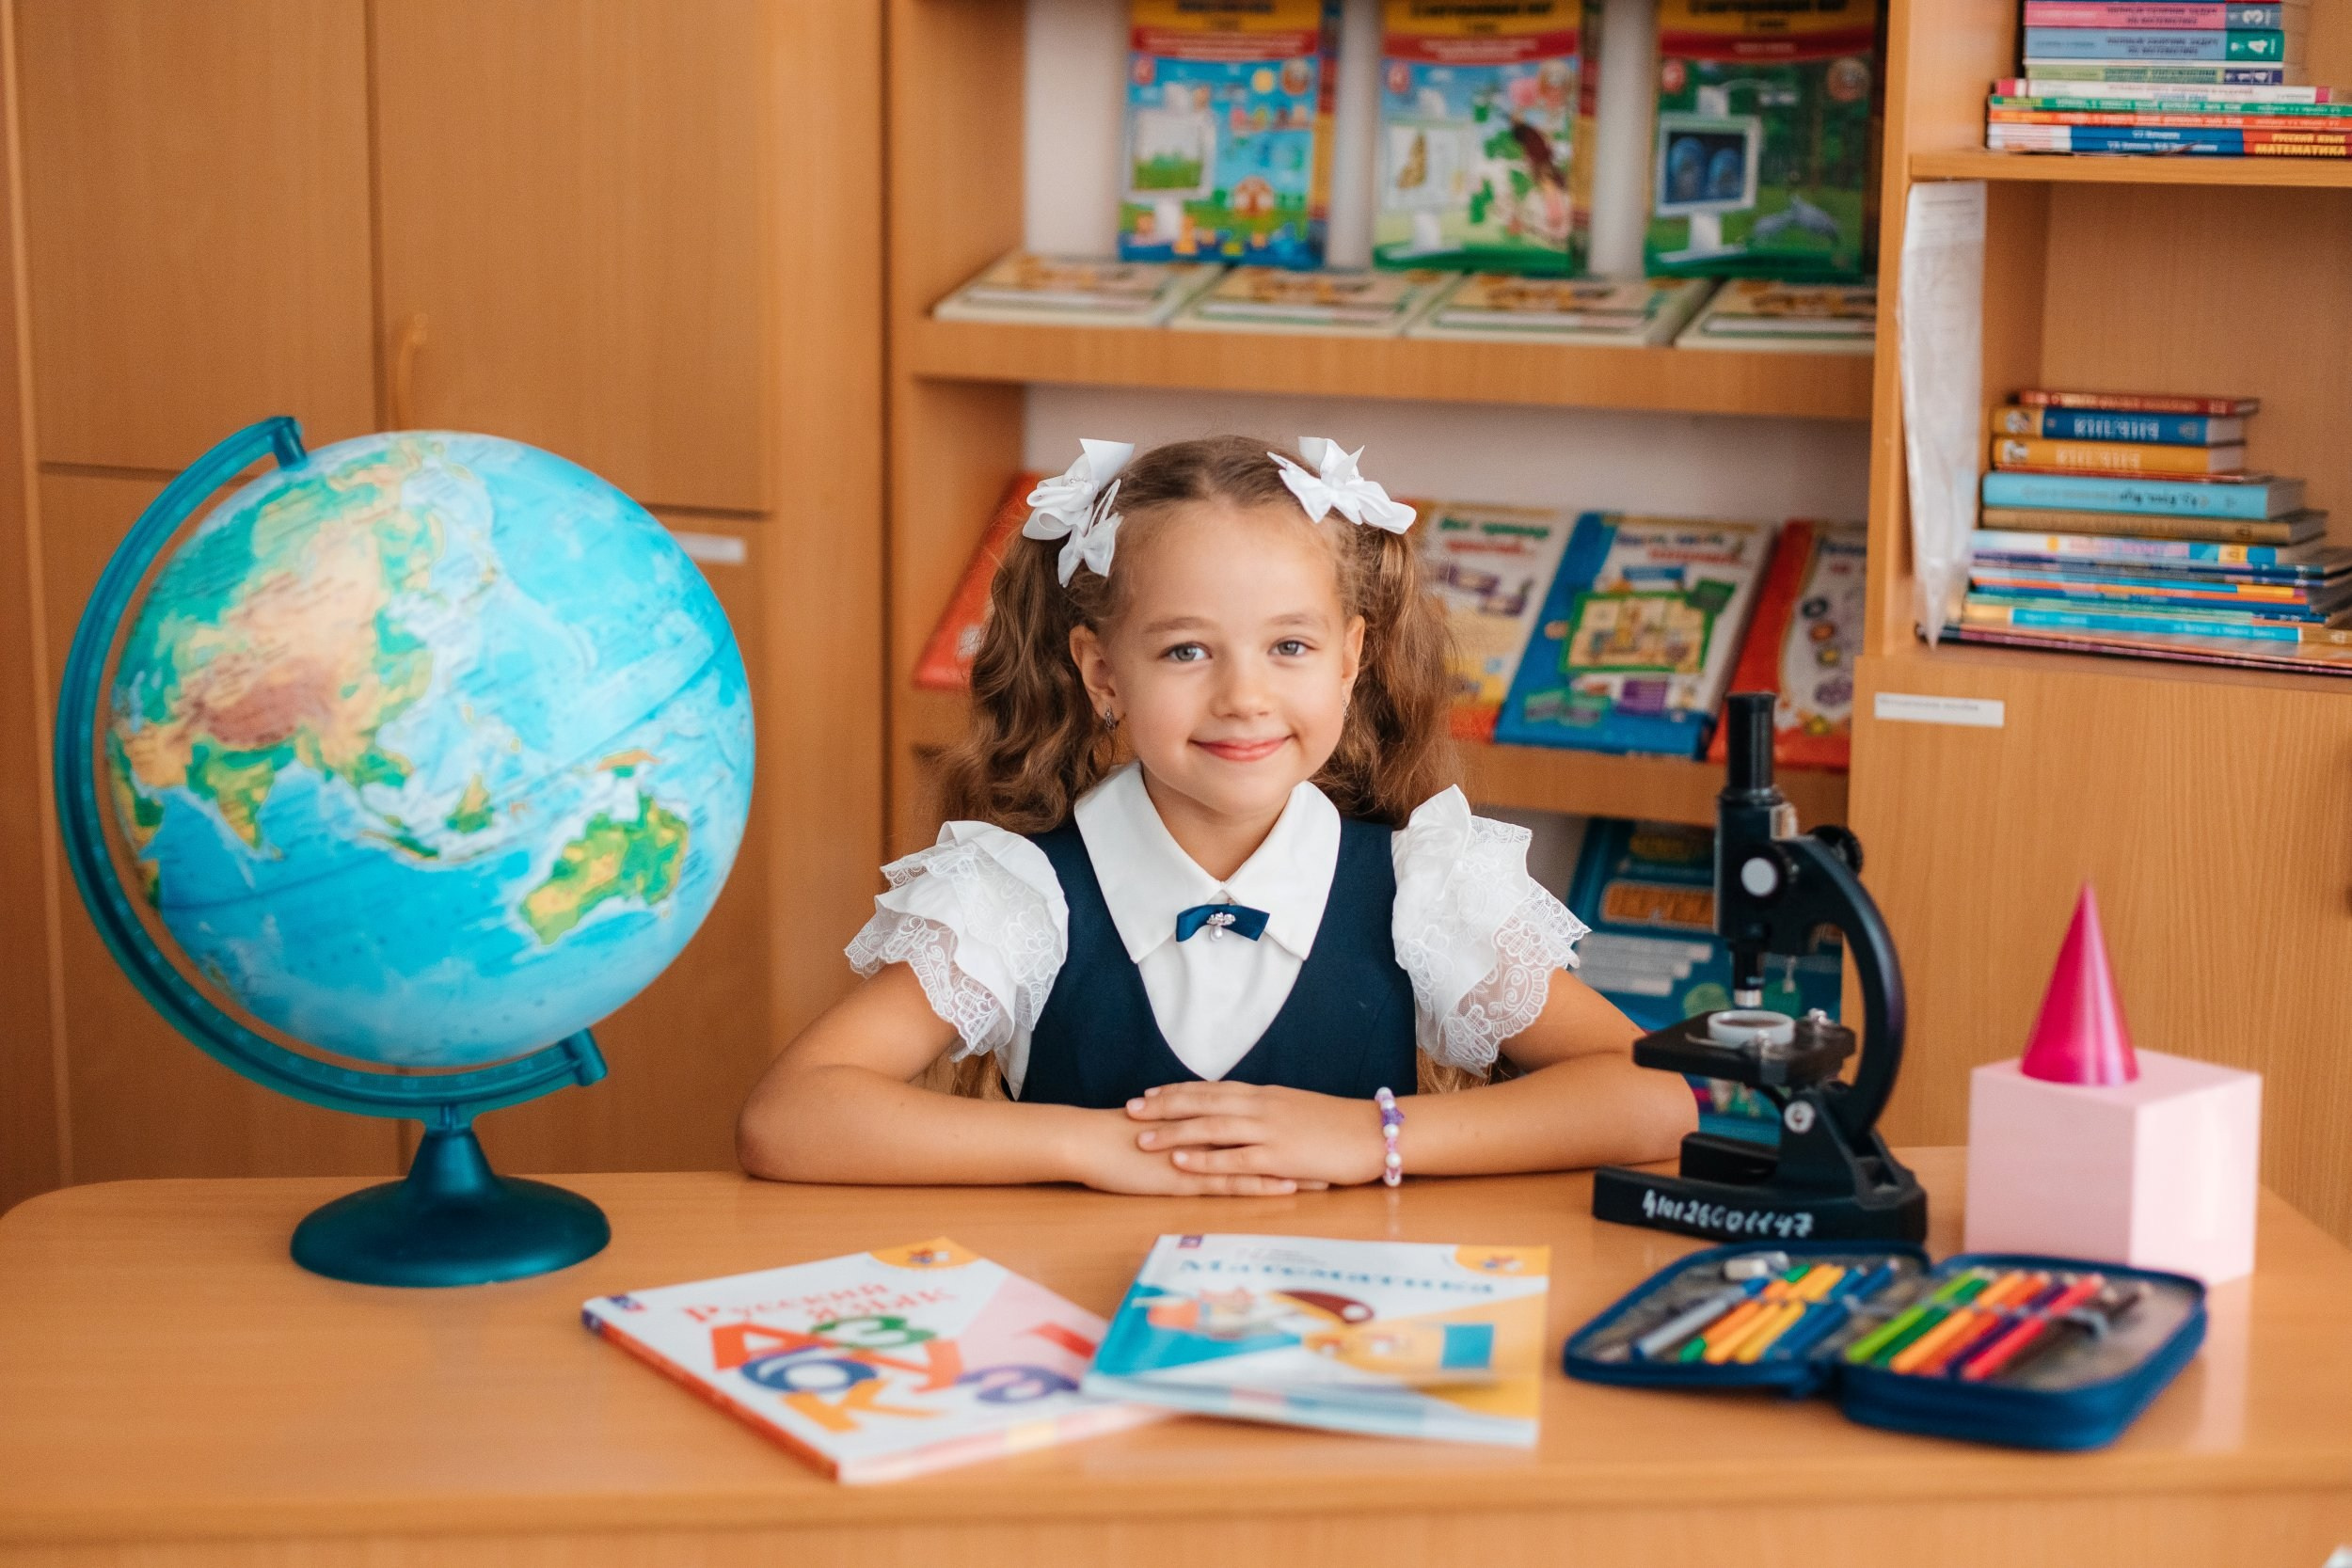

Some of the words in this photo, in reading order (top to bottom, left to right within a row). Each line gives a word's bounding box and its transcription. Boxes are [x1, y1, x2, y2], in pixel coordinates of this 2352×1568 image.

[2254, 143, 2346, 156] МАТЕМАТИКА
[1180, 1259, 1494, 1294] Математика
[681, 1282, 890, 1324] Русский
